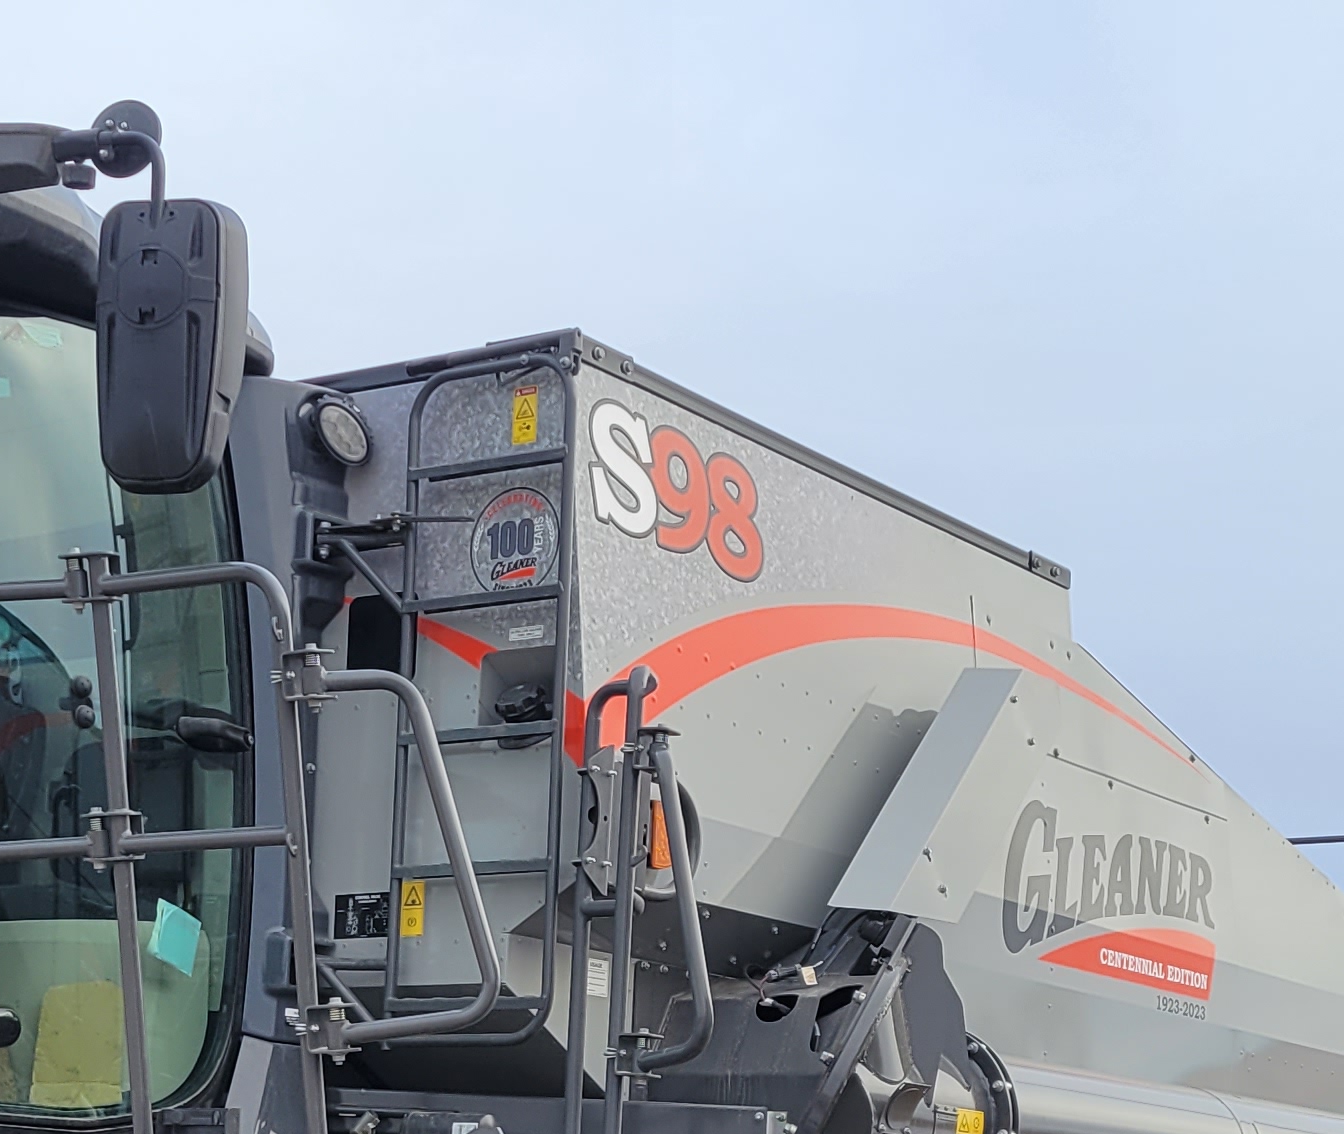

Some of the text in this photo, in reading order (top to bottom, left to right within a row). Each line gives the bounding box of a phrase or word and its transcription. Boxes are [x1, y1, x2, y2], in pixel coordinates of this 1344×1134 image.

[588, 398, 764, 583] S98
[487, 518, 535, 560] 100
[533, 516, 544, 554] YEARS
[491, 557, 537, 581] GLEANER
[1002, 799, 1215, 954] GLEANER
[1099, 948, 1208, 990] CENTENNIAL EDITION
[1156, 994, 1206, 1020] 1923-2023
